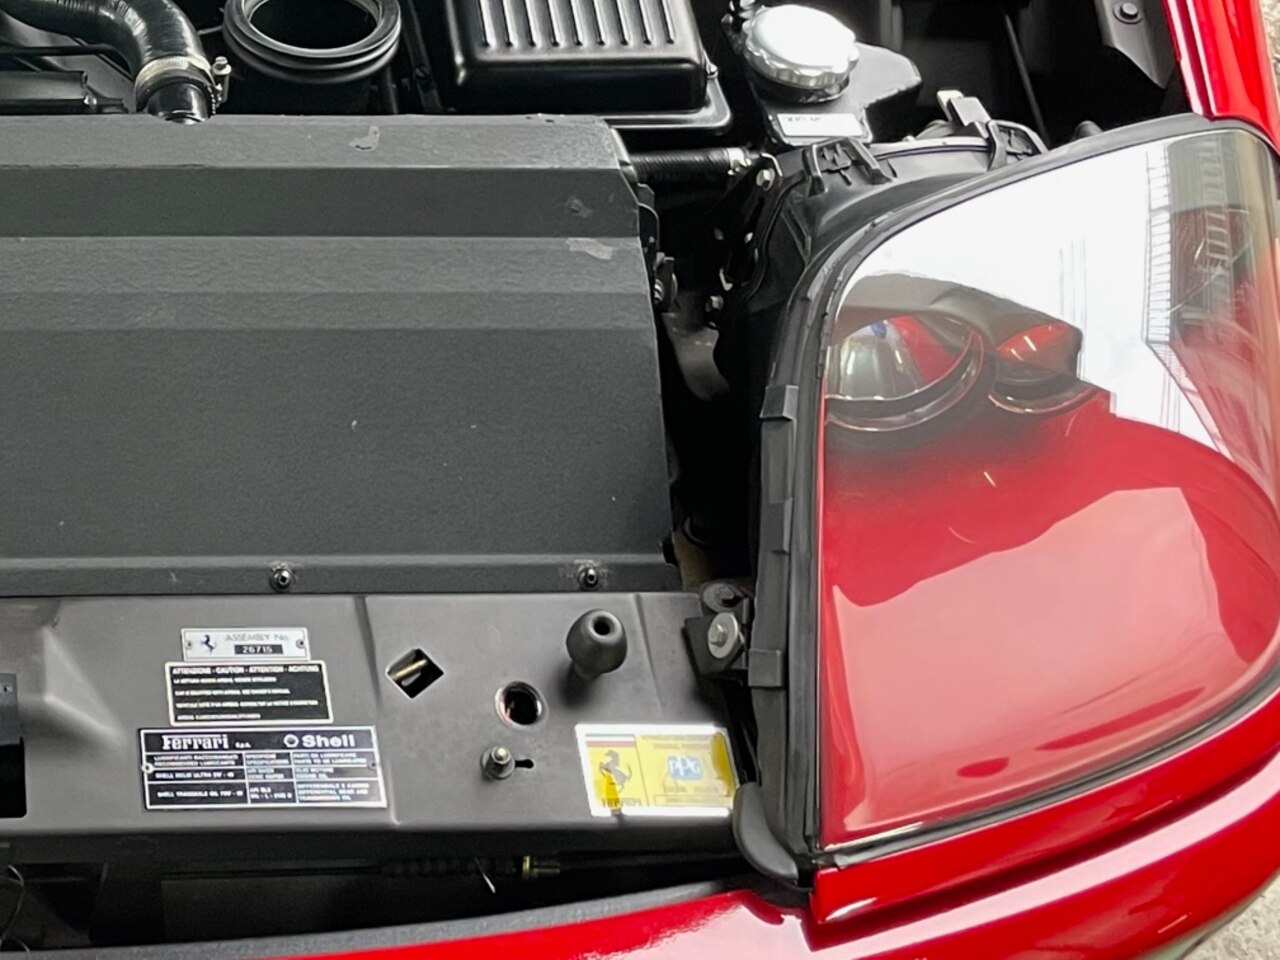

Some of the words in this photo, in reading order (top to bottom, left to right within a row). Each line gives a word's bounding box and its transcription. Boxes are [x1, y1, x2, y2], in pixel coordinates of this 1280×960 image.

[225, 633, 270, 642] ASSEMBLY
[242, 646, 273, 654] 26715
[172, 667, 212, 675] ATTENZIONE
[216, 666, 245, 674] CAUTION
[288, 665, 320, 673] ACHTUNG
[162, 734, 229, 750] Ferrari
[302, 734, 355, 747] Shell
[669, 757, 701, 777] PPG
